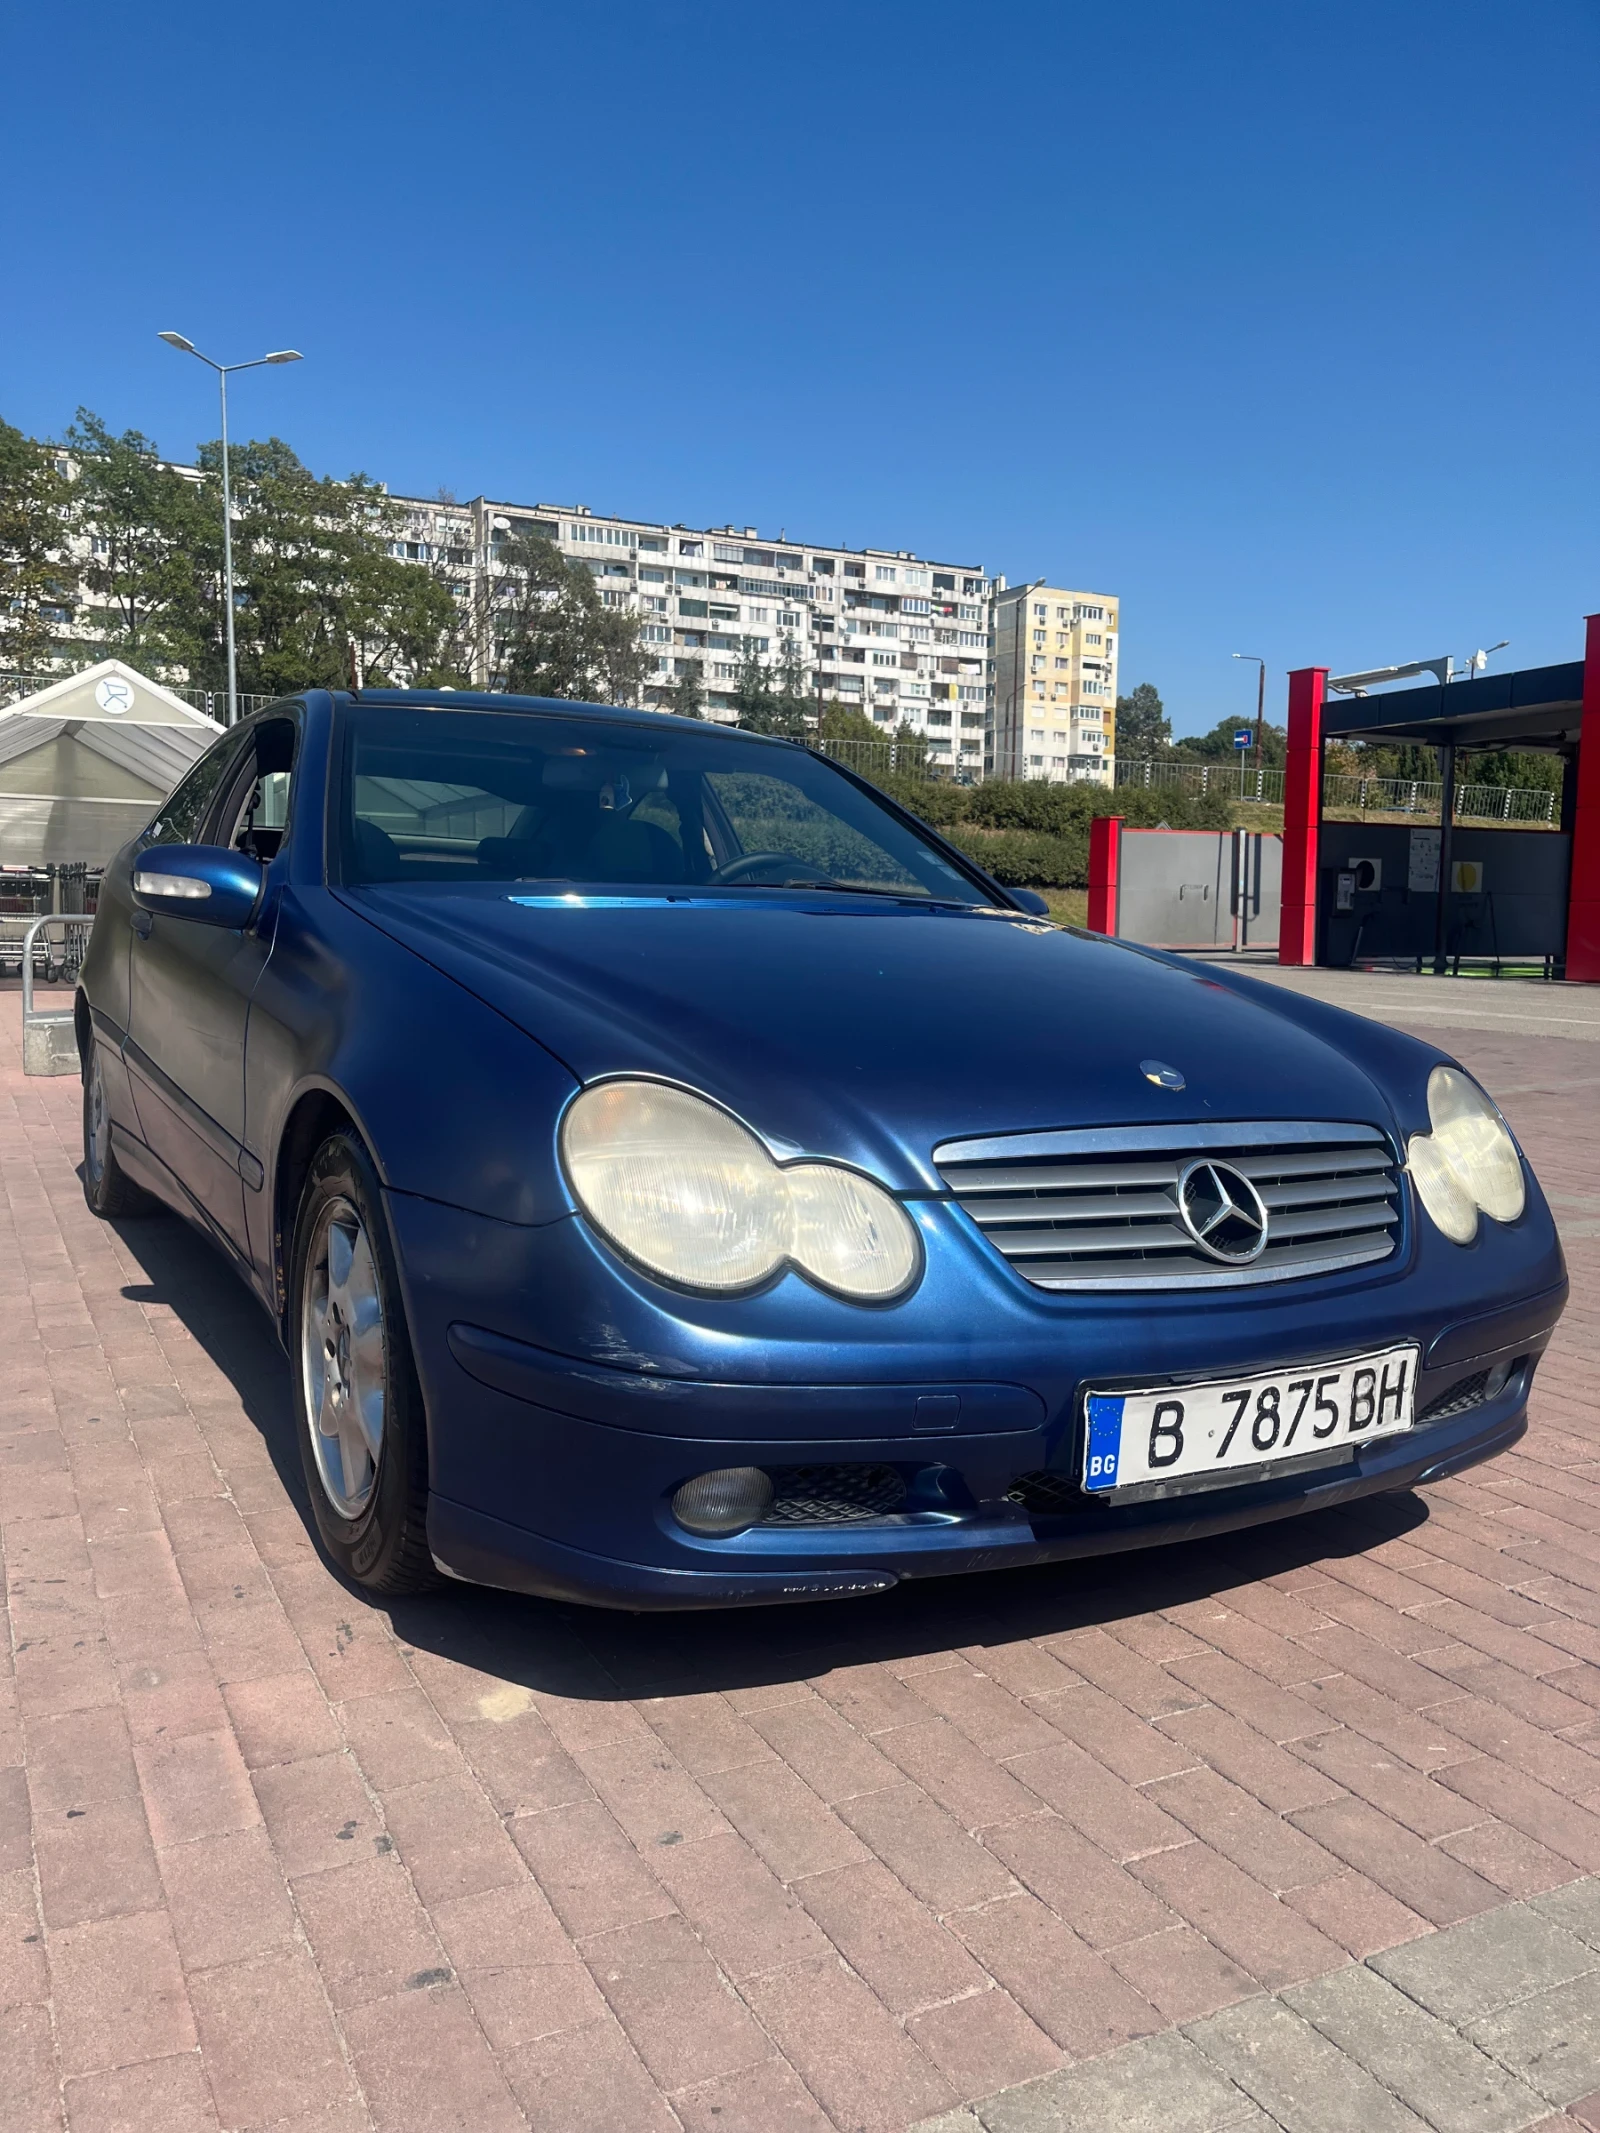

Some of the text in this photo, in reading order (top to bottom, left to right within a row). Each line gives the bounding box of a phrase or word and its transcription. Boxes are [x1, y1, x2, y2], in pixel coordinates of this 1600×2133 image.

[1148, 1360, 1407, 1468] B 7875 BH
[1090, 1454, 1116, 1476] BG
